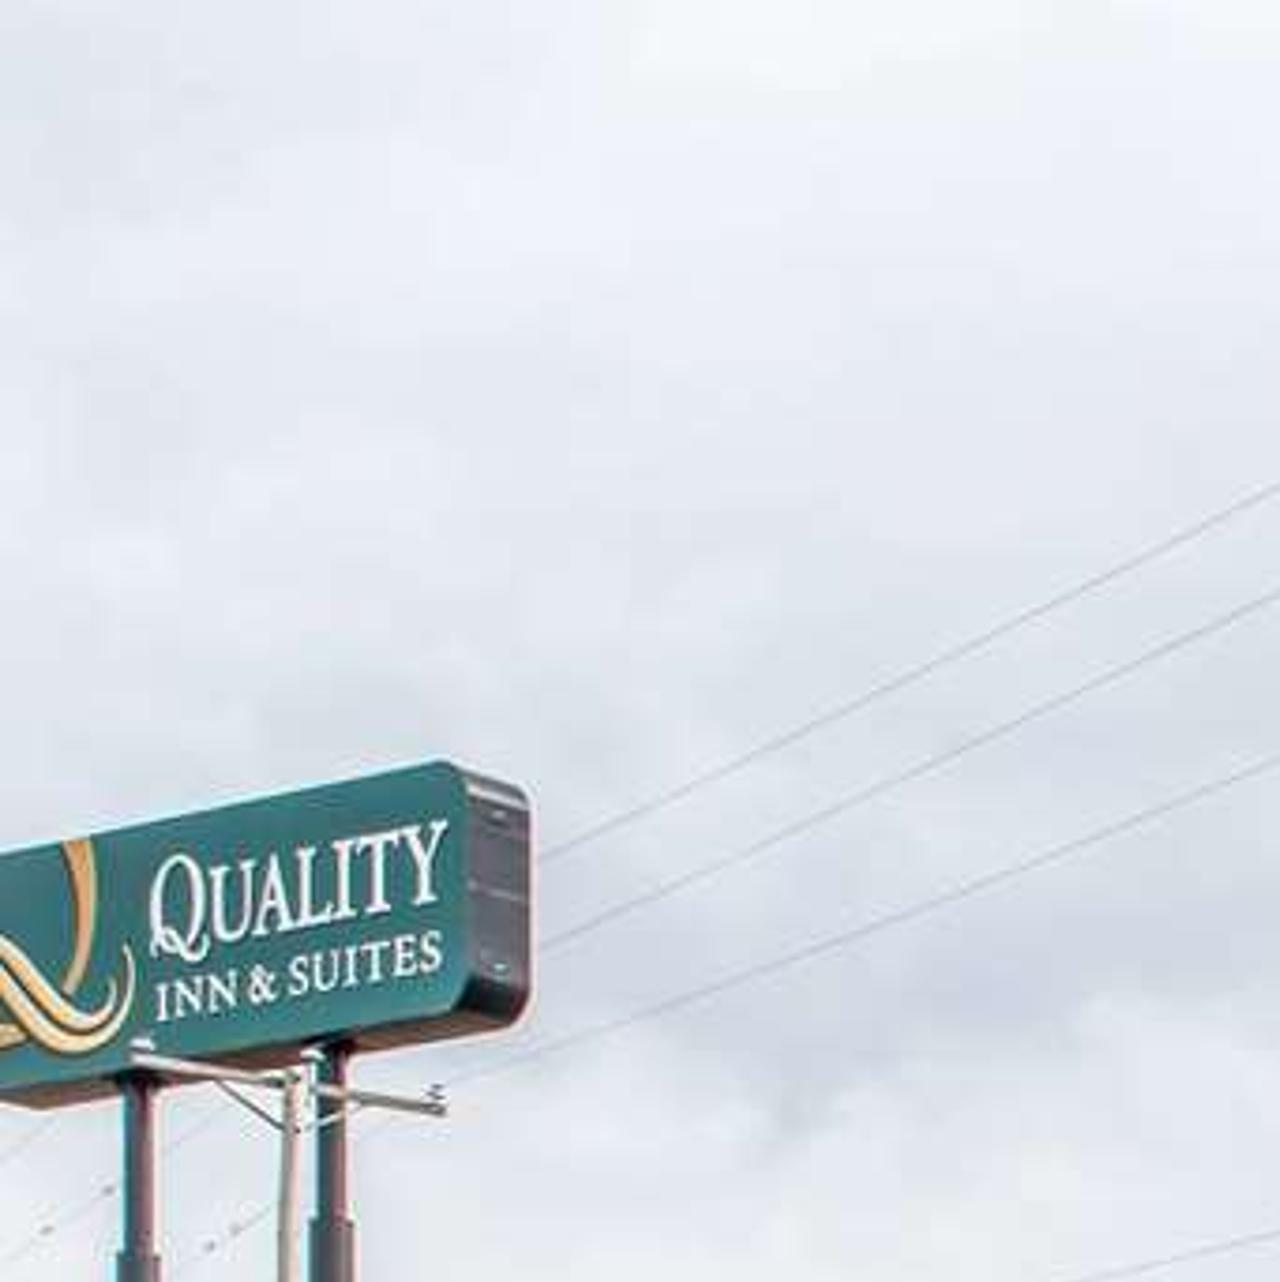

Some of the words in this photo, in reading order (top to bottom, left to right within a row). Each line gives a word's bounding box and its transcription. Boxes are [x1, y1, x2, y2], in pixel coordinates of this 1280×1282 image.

[149, 820, 449, 962] QUALITY
[155, 967, 239, 1022] INN
[248, 964, 279, 1004] &
[287, 930, 444, 998] SUITES
